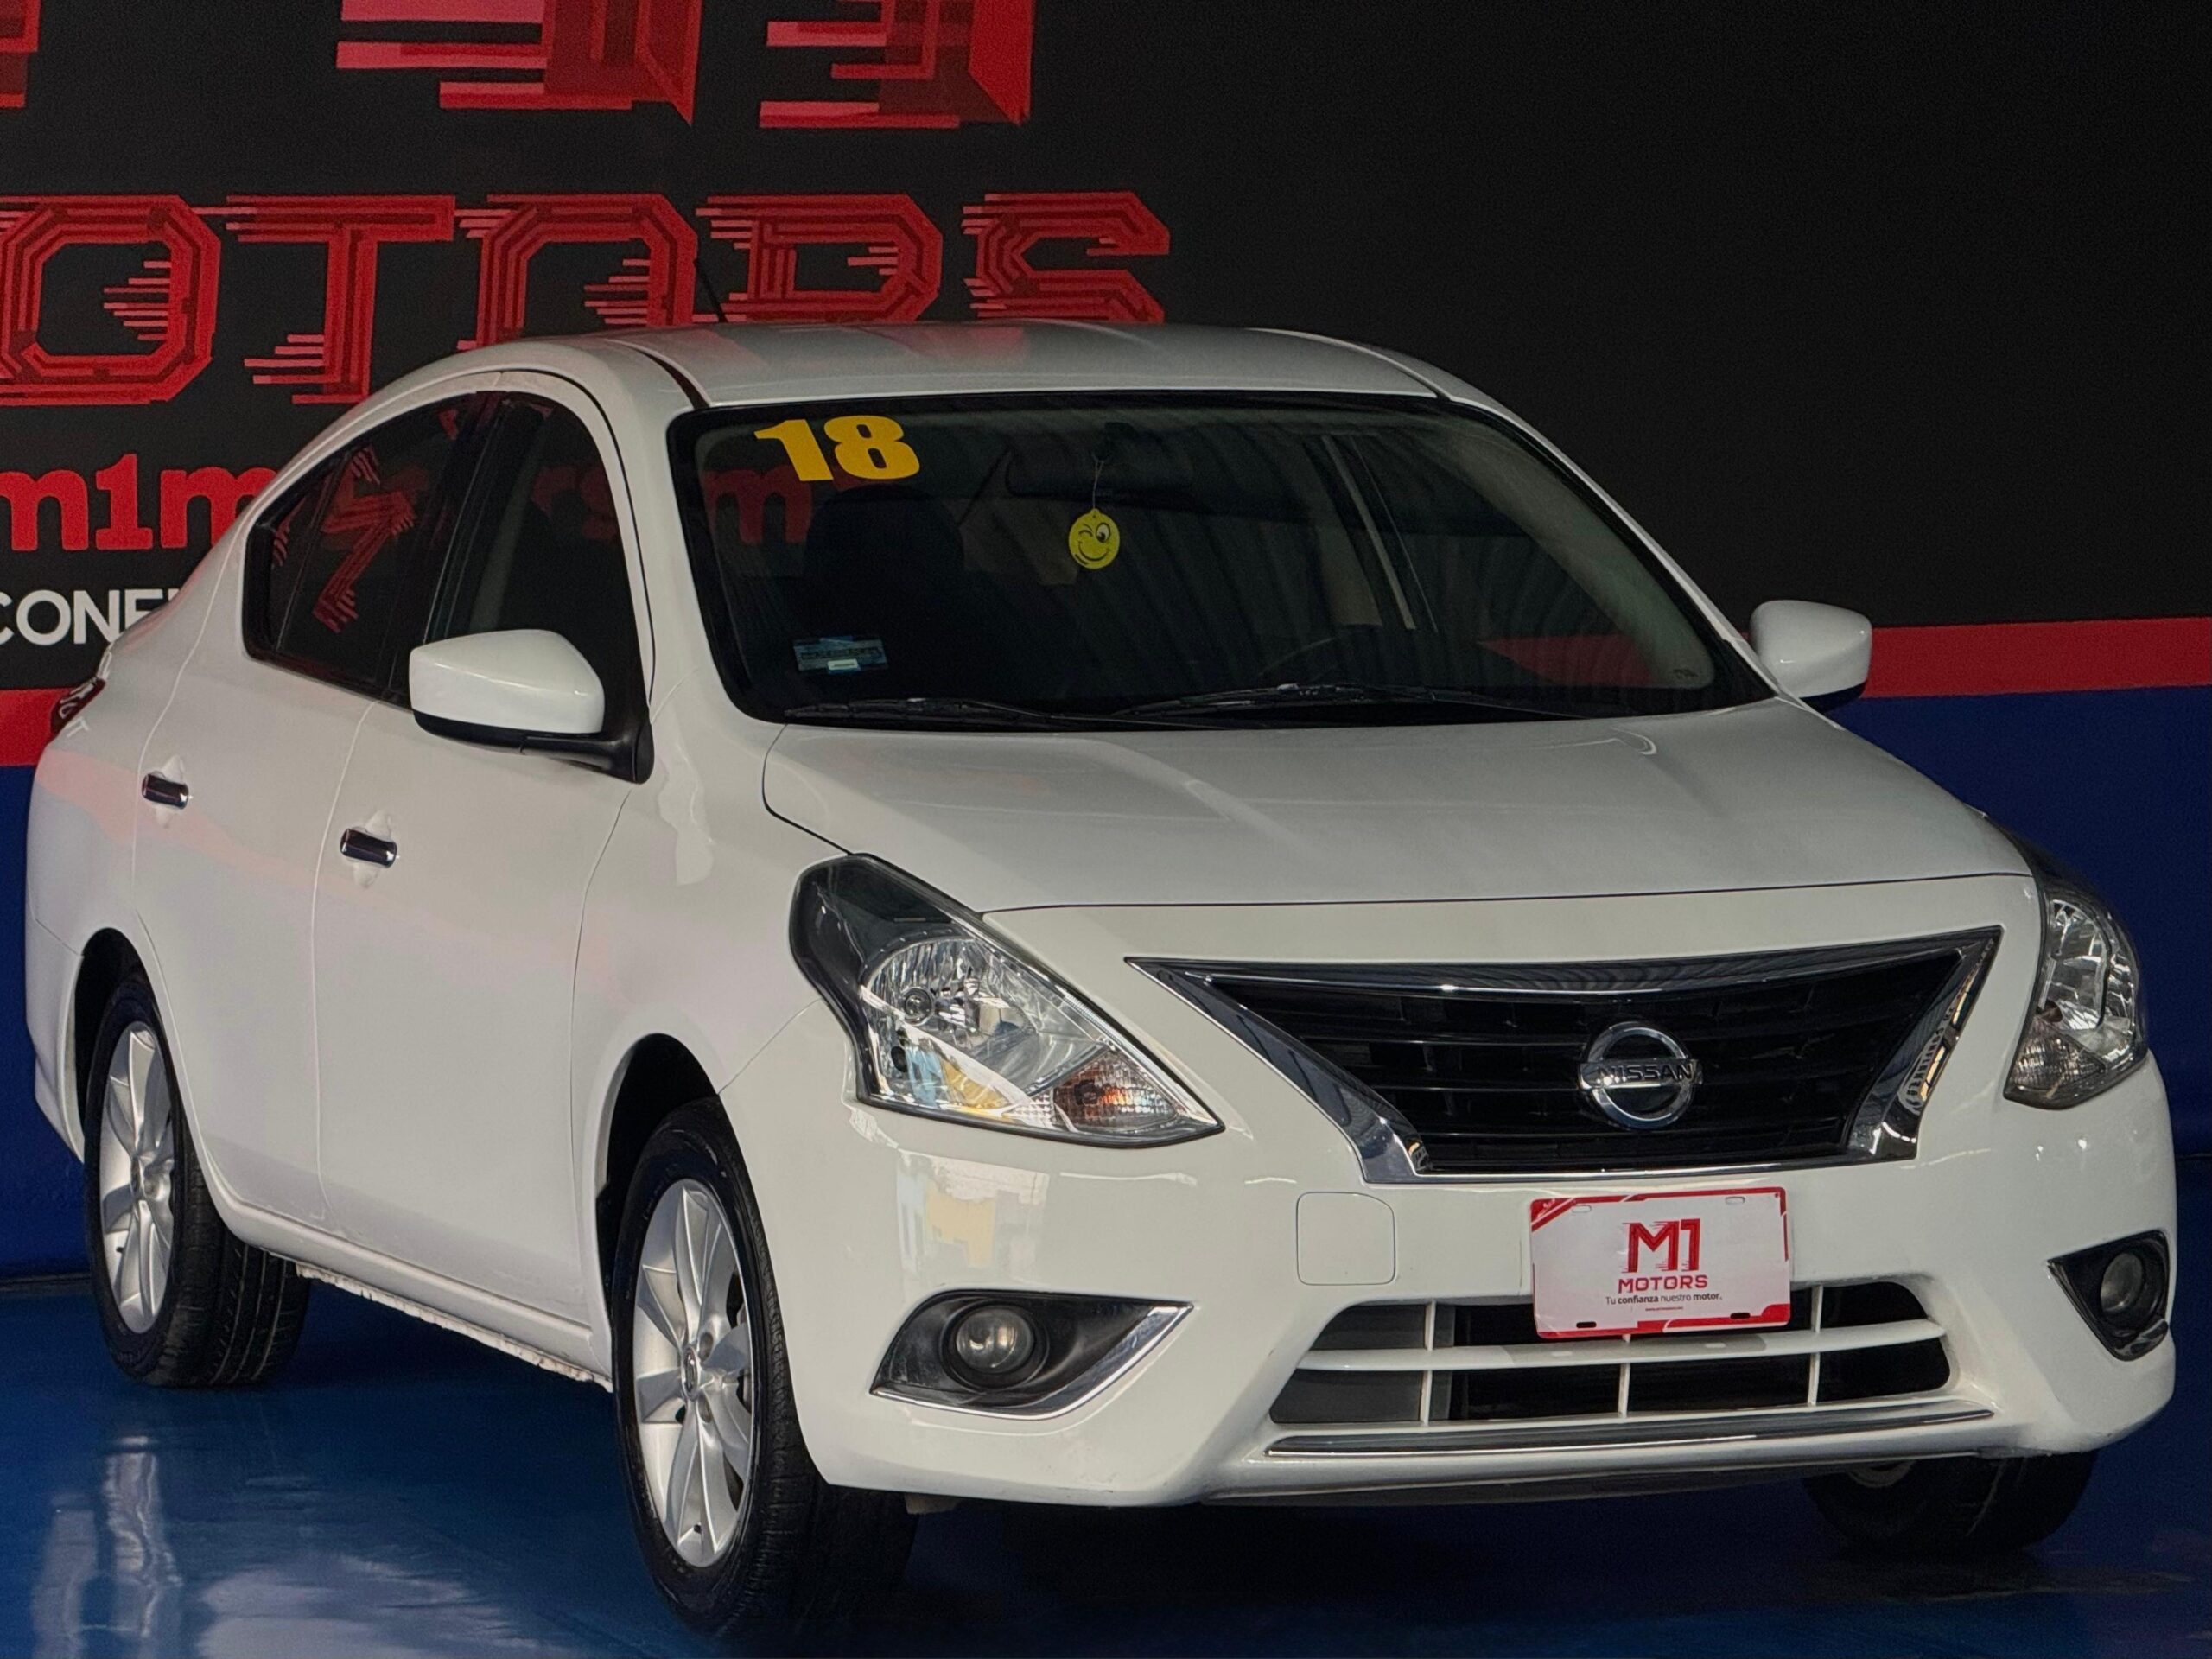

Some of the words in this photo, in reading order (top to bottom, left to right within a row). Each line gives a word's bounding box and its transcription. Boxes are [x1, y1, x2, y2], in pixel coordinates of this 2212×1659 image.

[754, 416, 920, 481] 18
[0, 588, 180, 646] ONF
[1598, 1063, 1693, 1081] NISSAN
[1620, 1218, 1700, 1274] M1
[1606, 1296, 1616, 1305] Tu
[1618, 1294, 1659, 1305] confianza
[1660, 1294, 1691, 1302] nuestro
[1618, 1274, 1708, 1294] MOTORS
